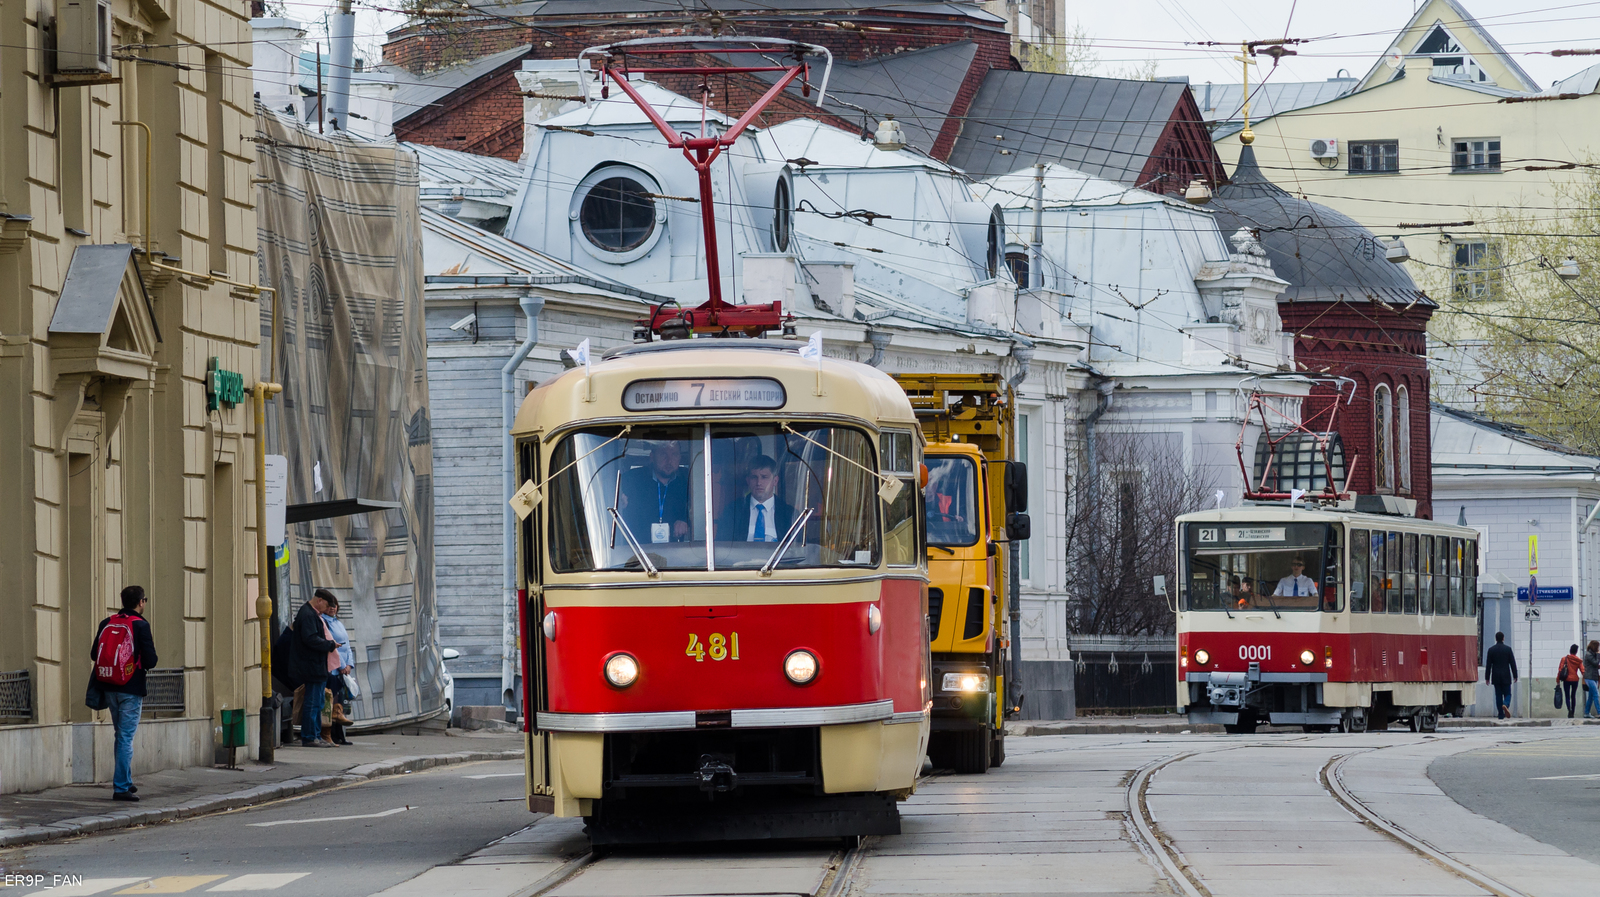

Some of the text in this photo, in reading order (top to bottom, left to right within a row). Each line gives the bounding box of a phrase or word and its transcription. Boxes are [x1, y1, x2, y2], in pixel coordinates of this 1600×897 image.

[635, 392, 679, 404] ОСТАНКИНО
[691, 383, 705, 406] 7
[709, 389, 741, 402] ДЕТСКИЙ
[1202, 530, 1214, 541] 21
[1238, 530, 1244, 538] 21
[685, 631, 740, 662] 481
[1239, 645, 1271, 660] 0001
[98, 666, 113, 677] RU
